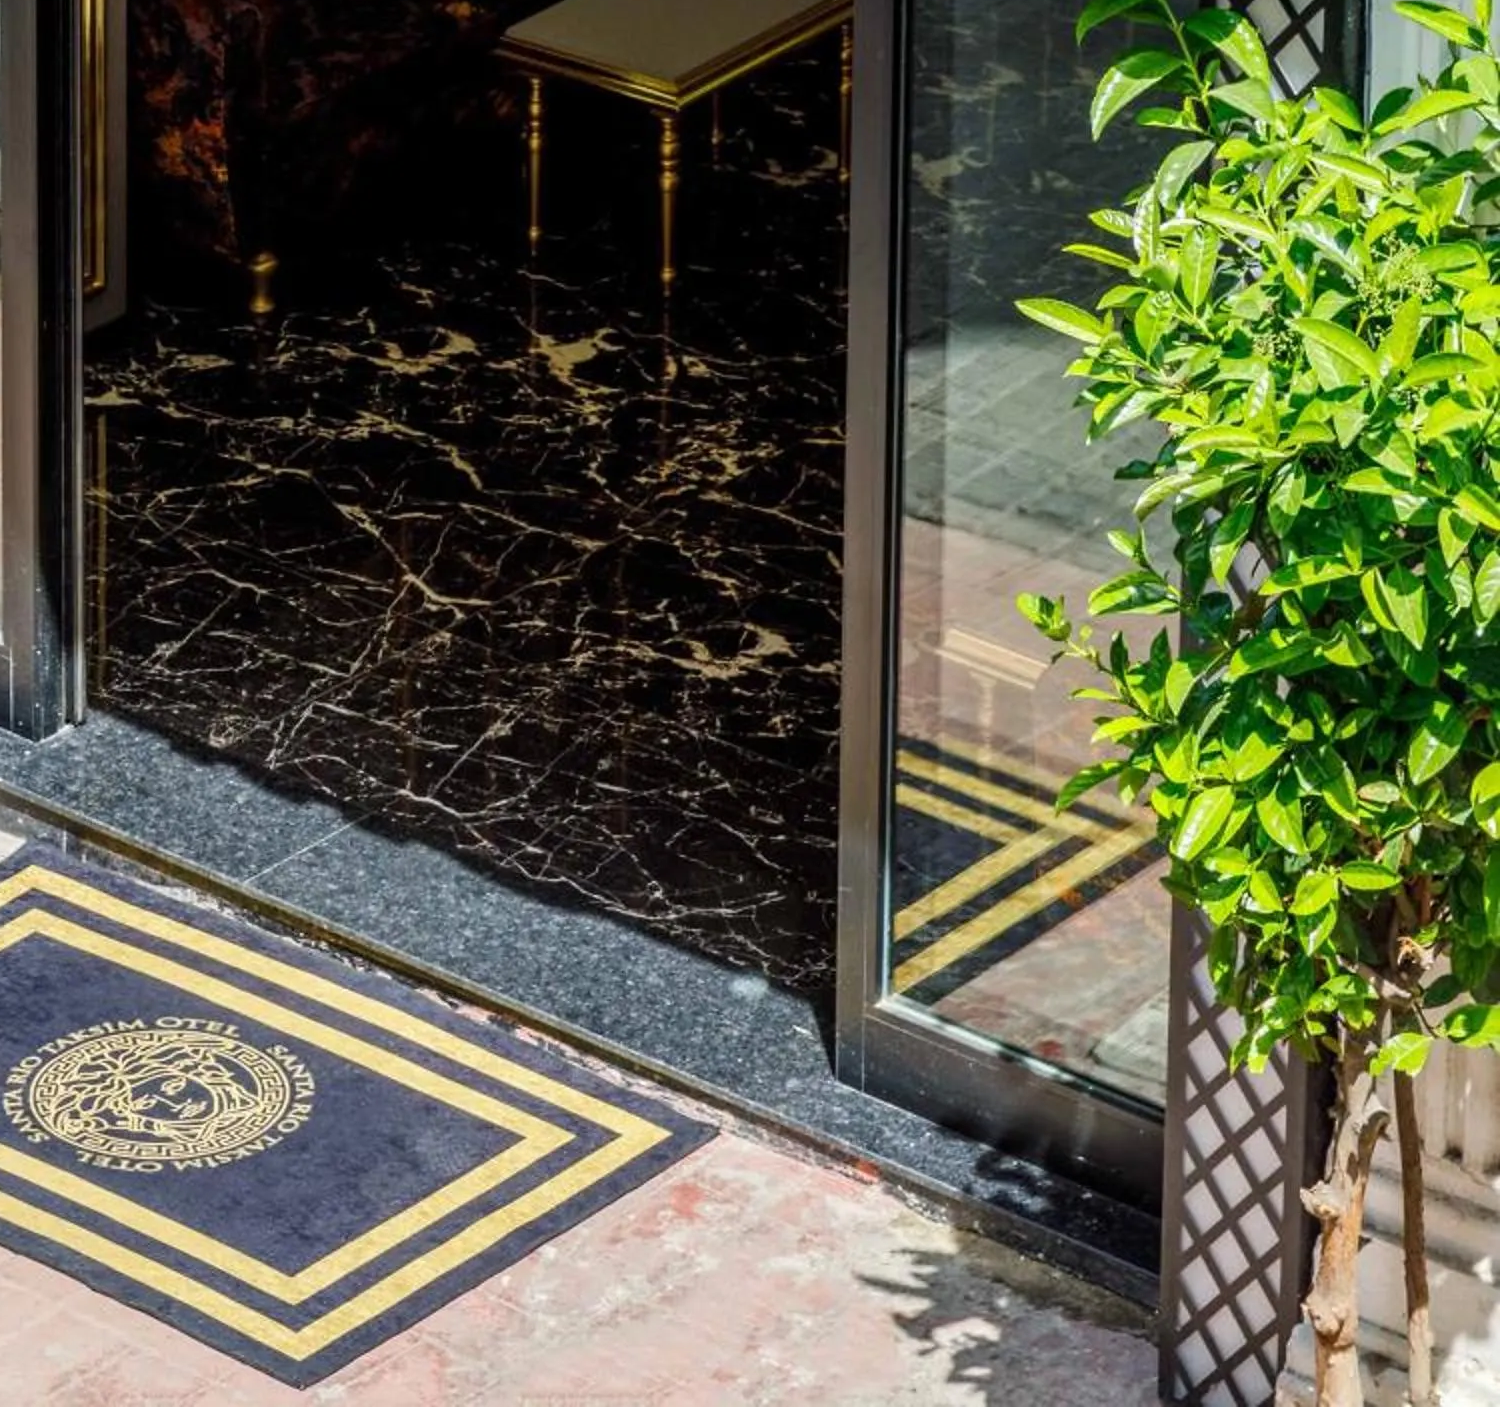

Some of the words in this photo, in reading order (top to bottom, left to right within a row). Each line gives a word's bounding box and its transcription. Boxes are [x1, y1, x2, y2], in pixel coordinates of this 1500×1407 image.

[155, 1015, 242, 1039] OTEL
[5, 1055, 43, 1084] RIO
[265, 1044, 316, 1100] SANTA
[2, 1088, 51, 1144] SANTA
[74, 1149, 165, 1174] OTEL
